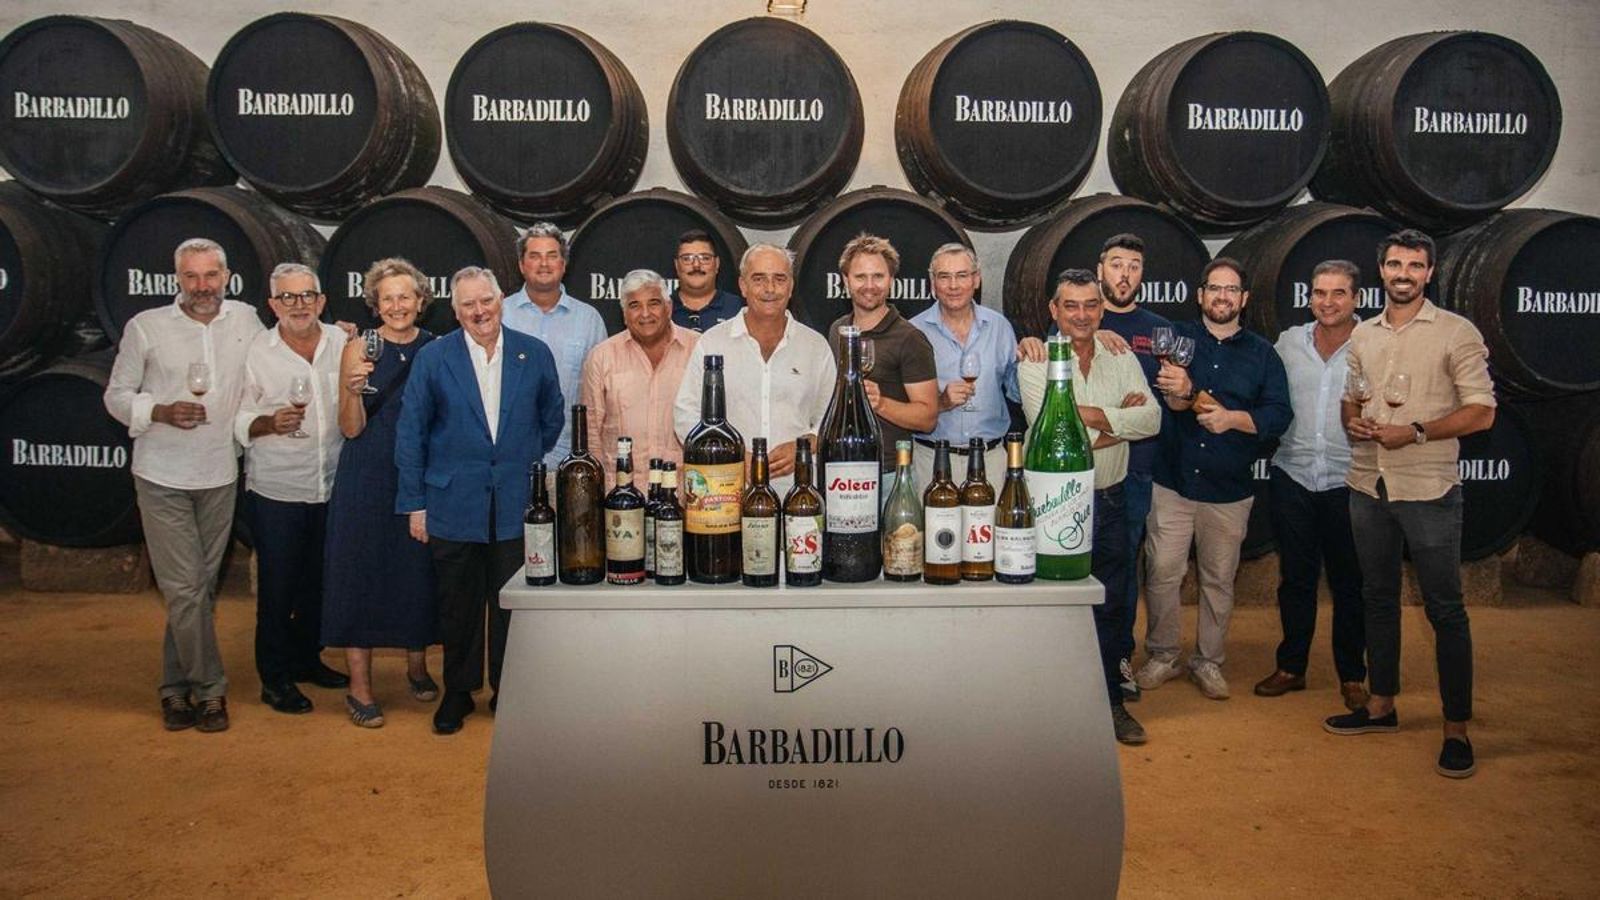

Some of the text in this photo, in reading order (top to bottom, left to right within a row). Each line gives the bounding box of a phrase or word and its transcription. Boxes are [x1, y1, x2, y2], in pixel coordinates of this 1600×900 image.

[14, 91, 130, 120] BARBADILLO
[238, 88, 355, 116] BARBADILLO
[472, 94, 591, 123] BARBADILLO
[705, 92, 824, 122] BARBADILLO
[955, 94, 1073, 124] BARBADILLO
[1187, 103, 1304, 132] BARBADILLO
[1414, 106, 1528, 135] BARBADILLO
[128, 268, 244, 296] BARBO
[1517, 286, 1600, 314] BARBADI
[13, 438, 127, 468] BARBADILLO
[828, 477, 877, 491] Solear
[779, 659, 815, 678] B 1821
[702, 721, 905, 765] BARBADILLO
[768, 779, 839, 789] DESDE 1821
